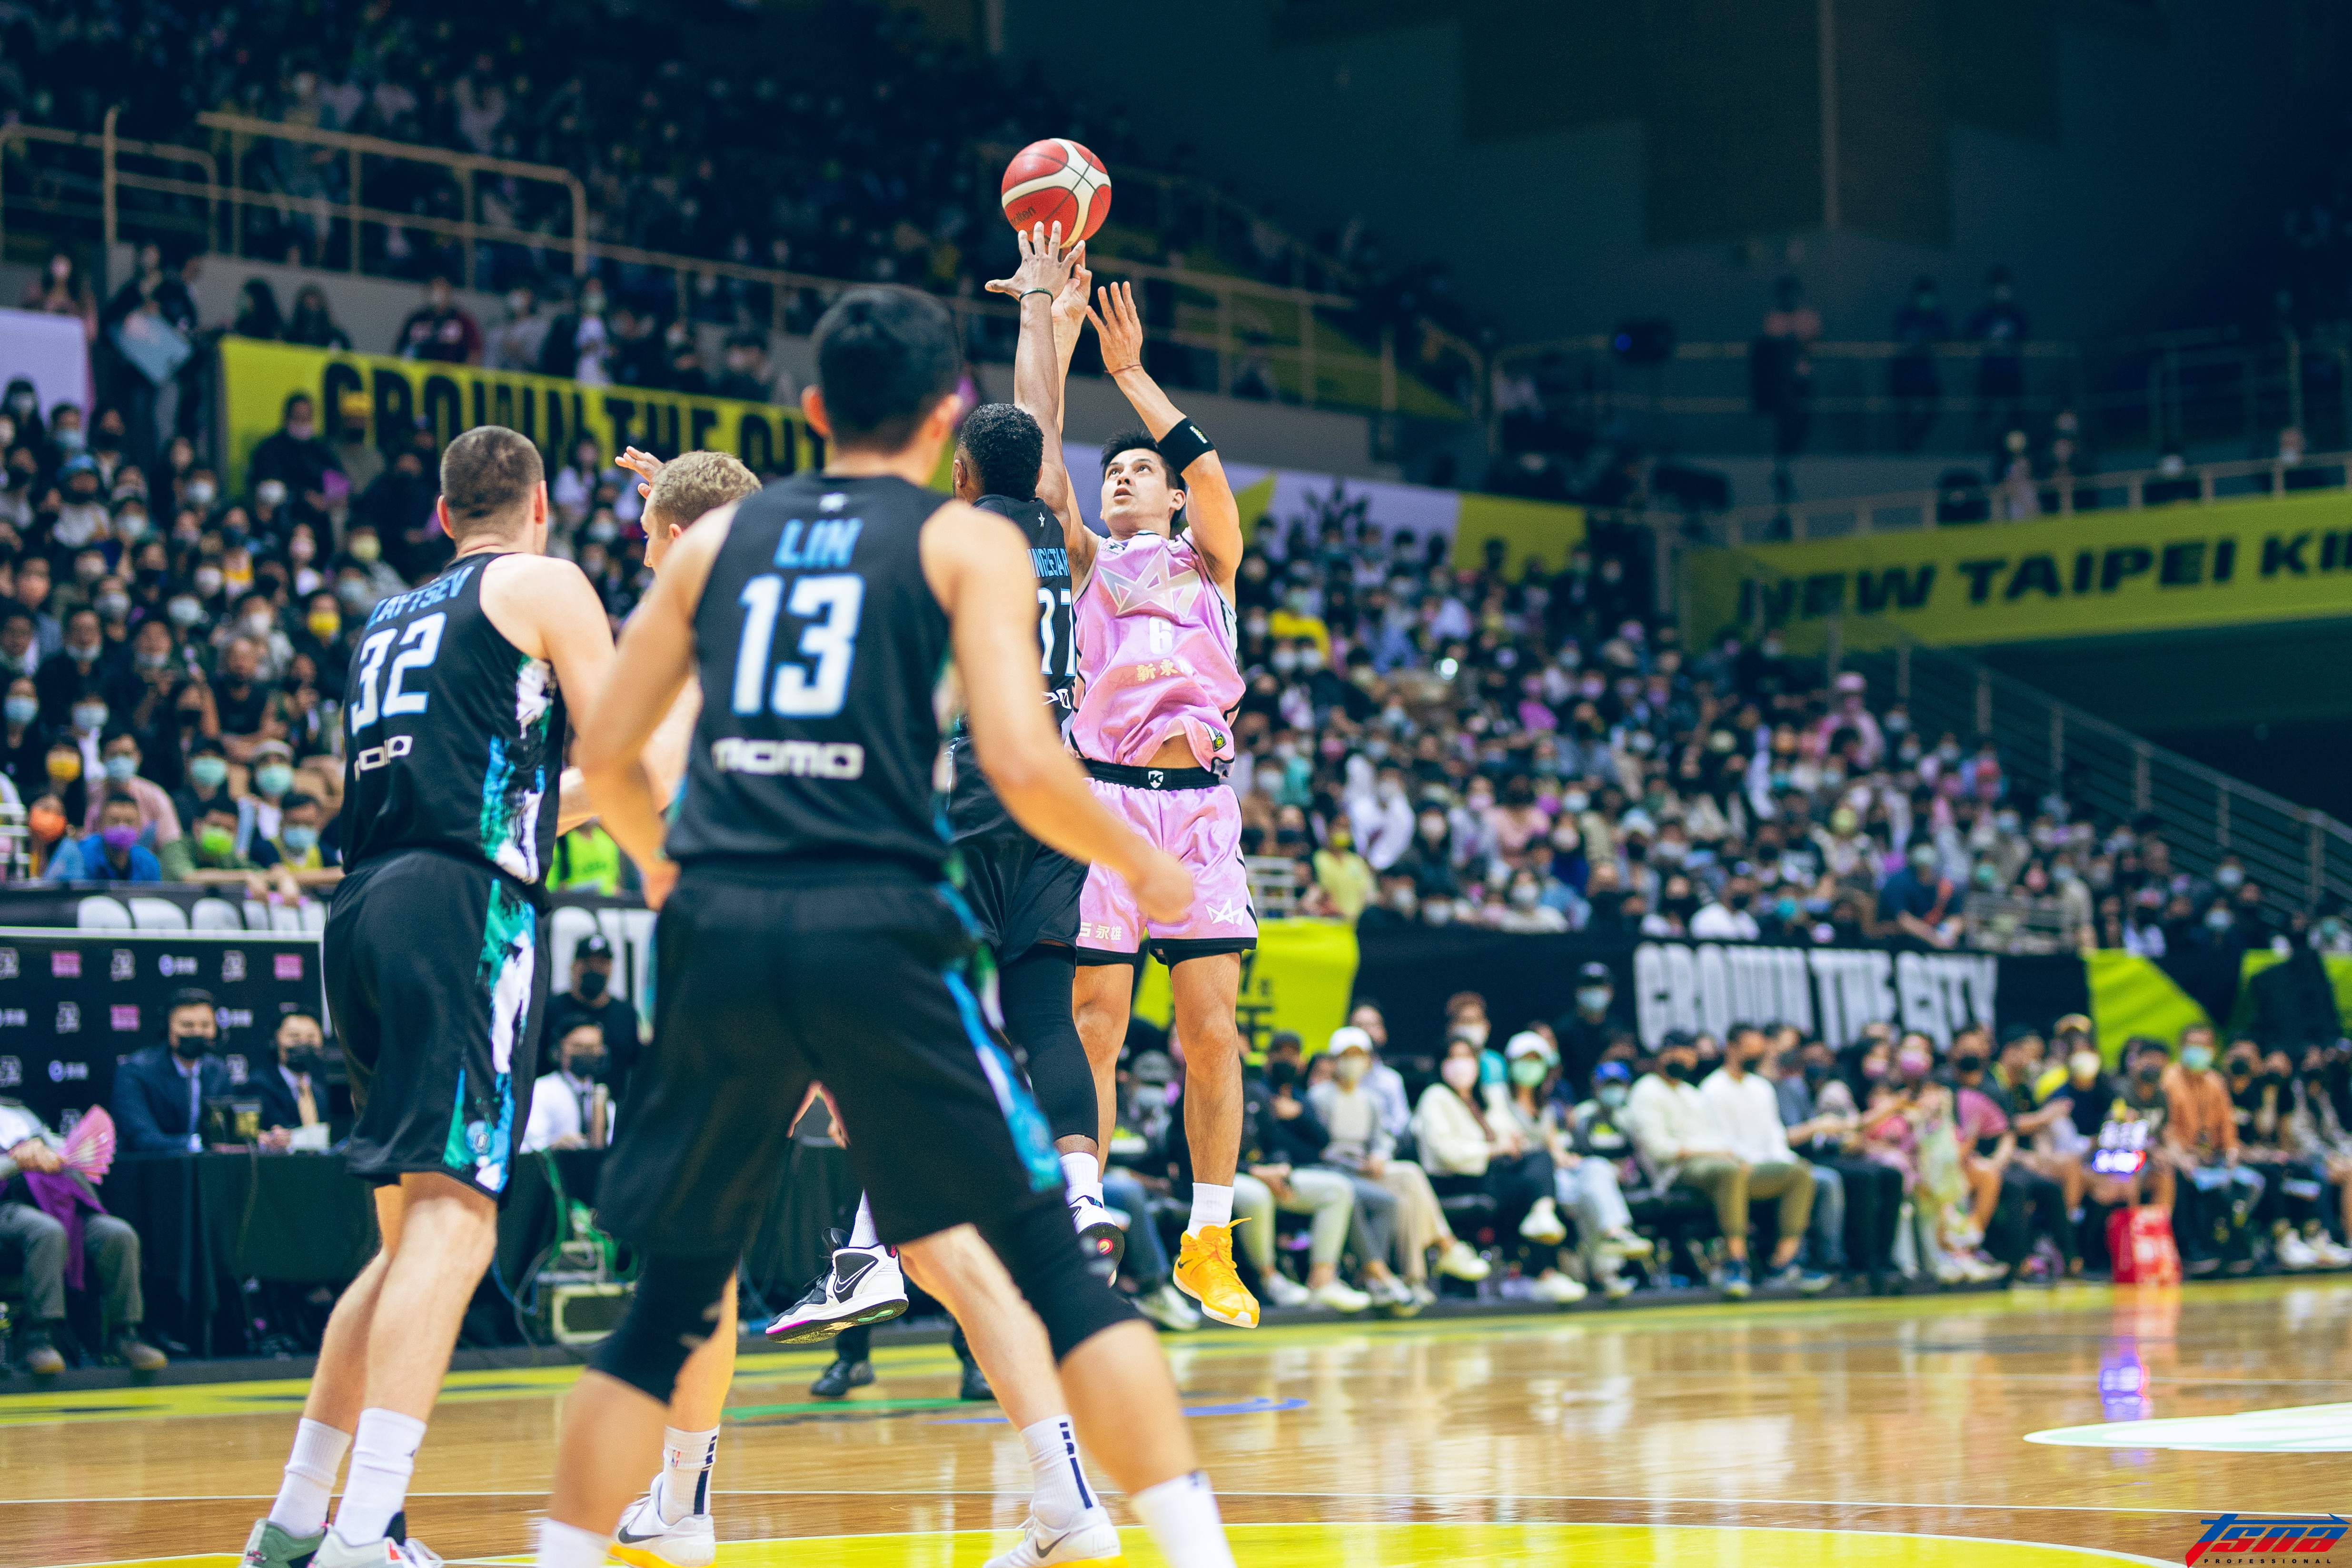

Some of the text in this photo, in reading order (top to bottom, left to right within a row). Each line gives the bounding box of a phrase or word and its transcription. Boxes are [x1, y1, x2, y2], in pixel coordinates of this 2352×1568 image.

[773, 518, 863, 568] LIN
[1957, 534, 2237, 610] TAIPEI
[731, 572, 866, 718] 13
[1149, 616, 1173, 655] 6
[350, 611, 447, 738] 32
[1136, 658, 1193, 682] 新東
